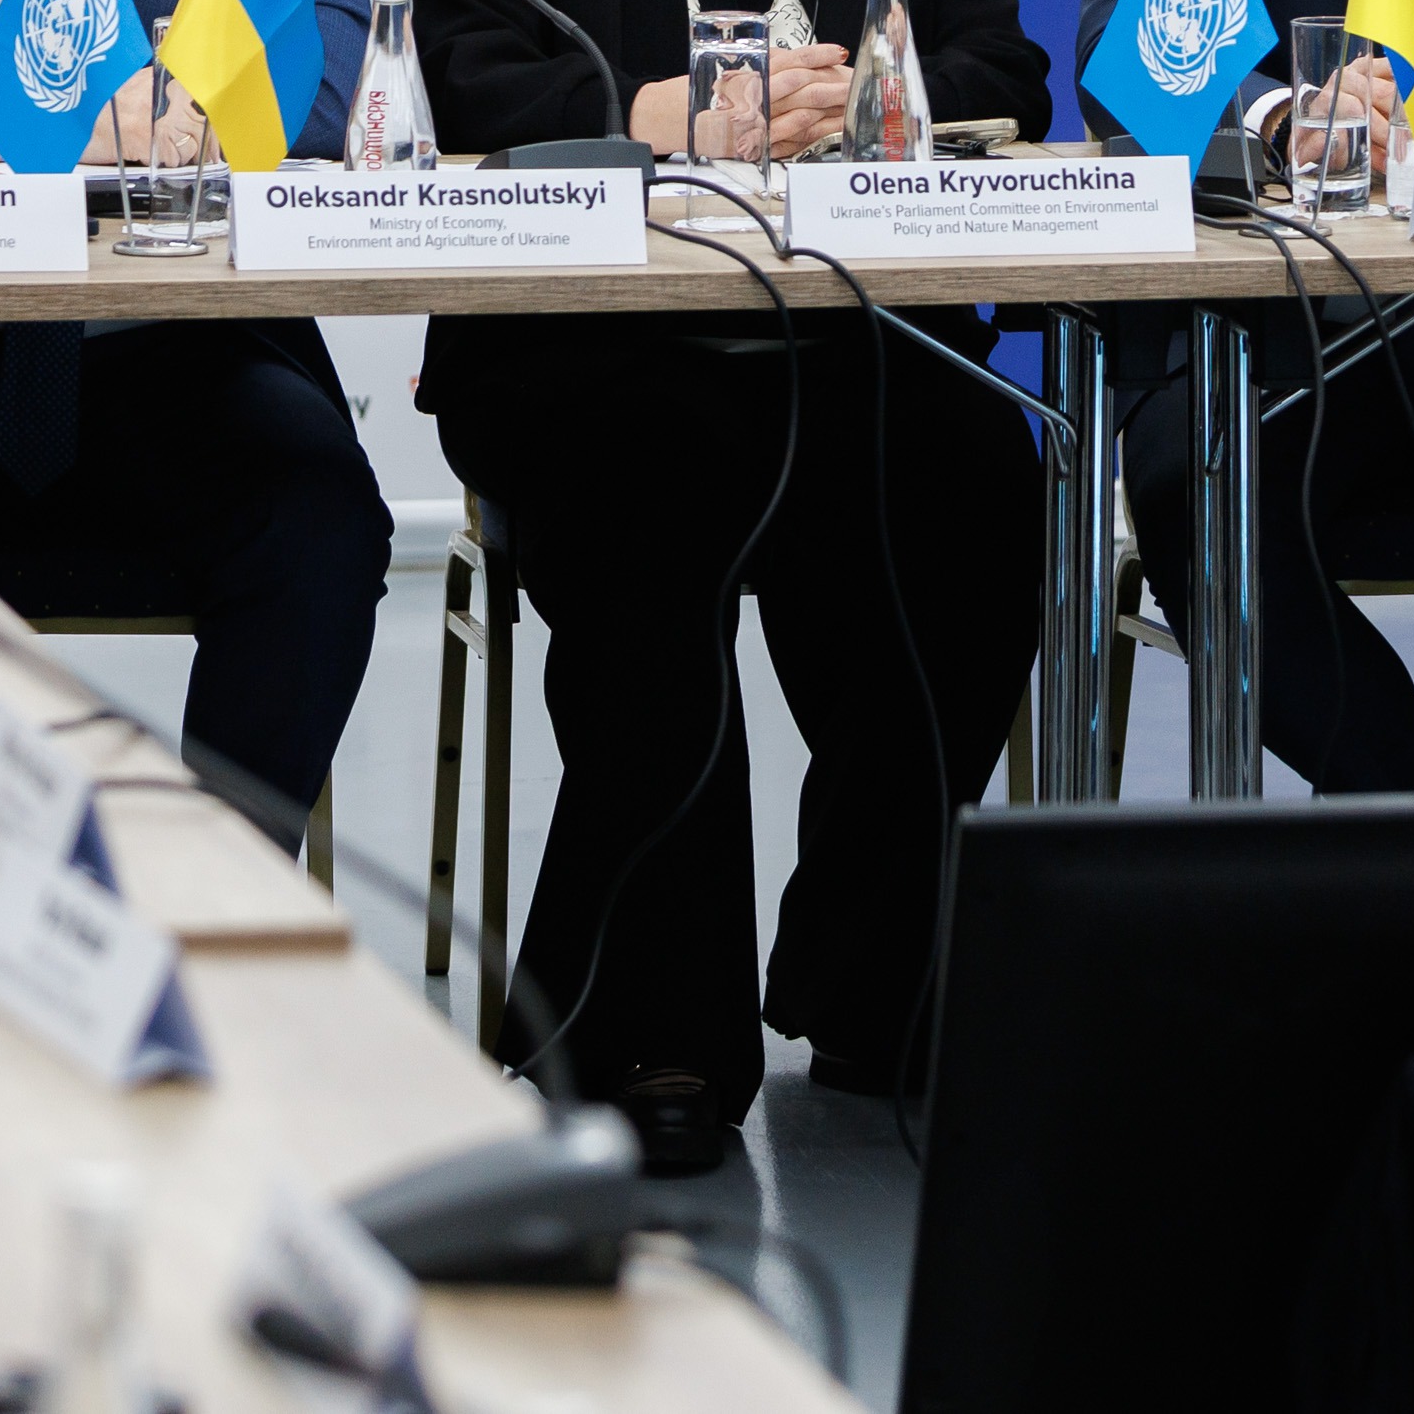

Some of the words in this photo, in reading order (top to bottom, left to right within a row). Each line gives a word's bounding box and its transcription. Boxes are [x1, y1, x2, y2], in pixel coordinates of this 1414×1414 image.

[850, 172, 931, 197] Olena
[940, 167, 1137, 200] Kryvoruchkina
[267, 185, 410, 210] Oleksandr
[419, 181, 607, 212] Krasnolutskyi
[895, 204, 967, 219] Parliament
[969, 202, 1042, 217] Committee
[1045, 204, 1063, 216] on
[1065, 199, 1160, 215] Environmental
[370, 217, 423, 234] Ministry
[425, 215, 440, 231] of
[443, 215, 508, 232] Economy,
[894, 222, 933, 239] Policy
[936, 221, 962, 236] and
[965, 221, 1010, 235] Nature
[1012, 219, 1099, 236] Management
[308, 235, 394, 251] Environment
[396, 234, 423, 250] and
[425, 233, 499, 252] Agriculture
[501, 232, 516, 248] of
[518, 232, 572, 248] Ukraine
